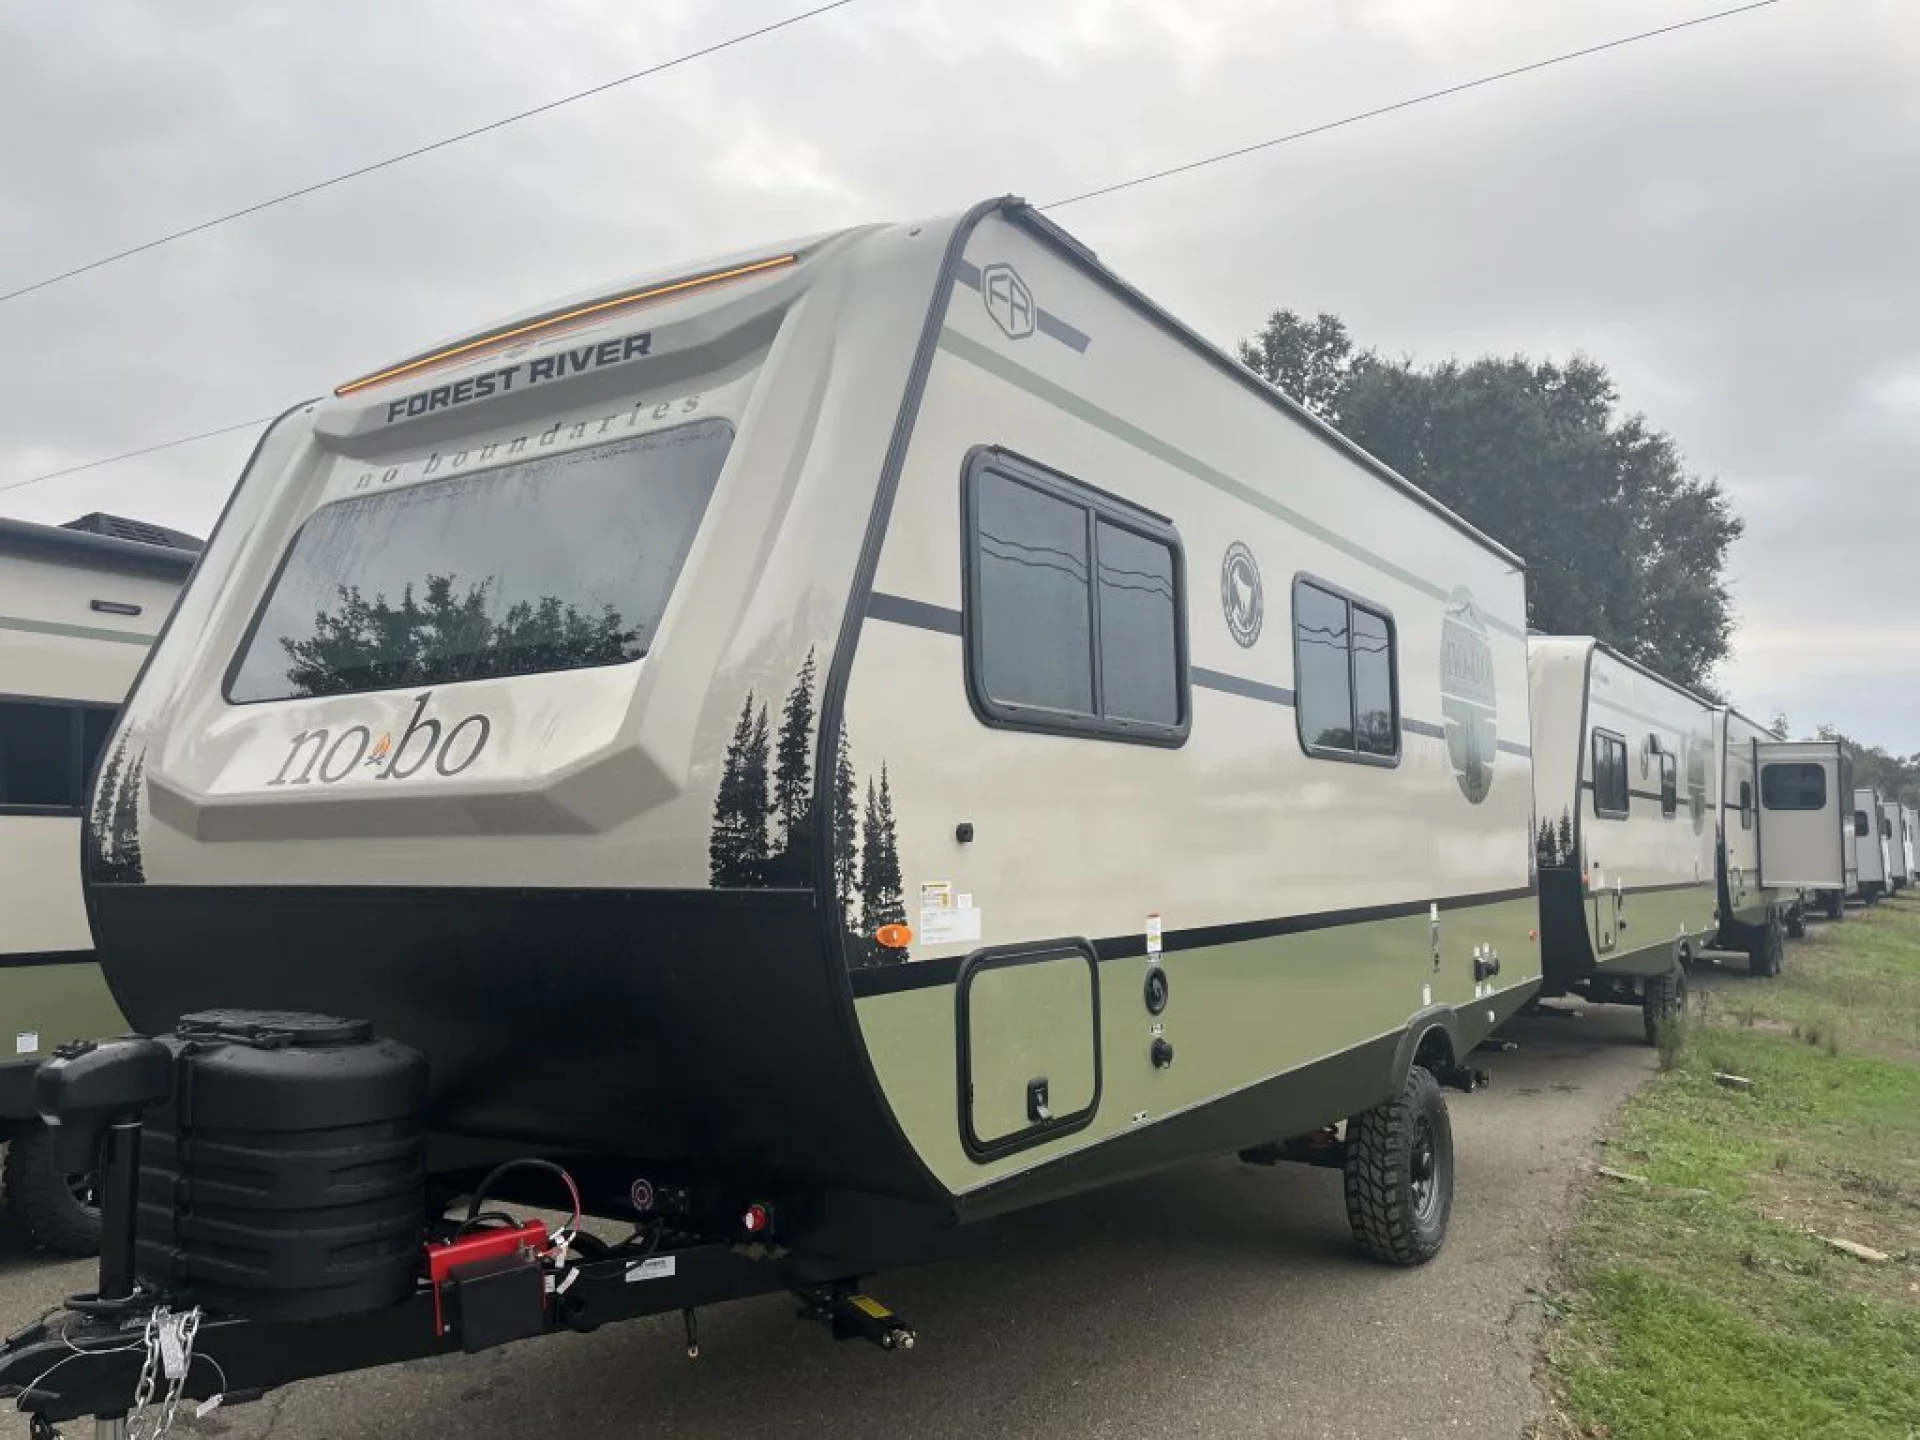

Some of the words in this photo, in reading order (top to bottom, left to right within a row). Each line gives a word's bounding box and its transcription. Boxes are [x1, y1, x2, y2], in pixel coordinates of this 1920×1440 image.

[387, 365, 521, 423] FOREST
[529, 331, 652, 384] RIVER
[356, 466, 399, 490] no
[422, 397, 700, 475] boundaries
